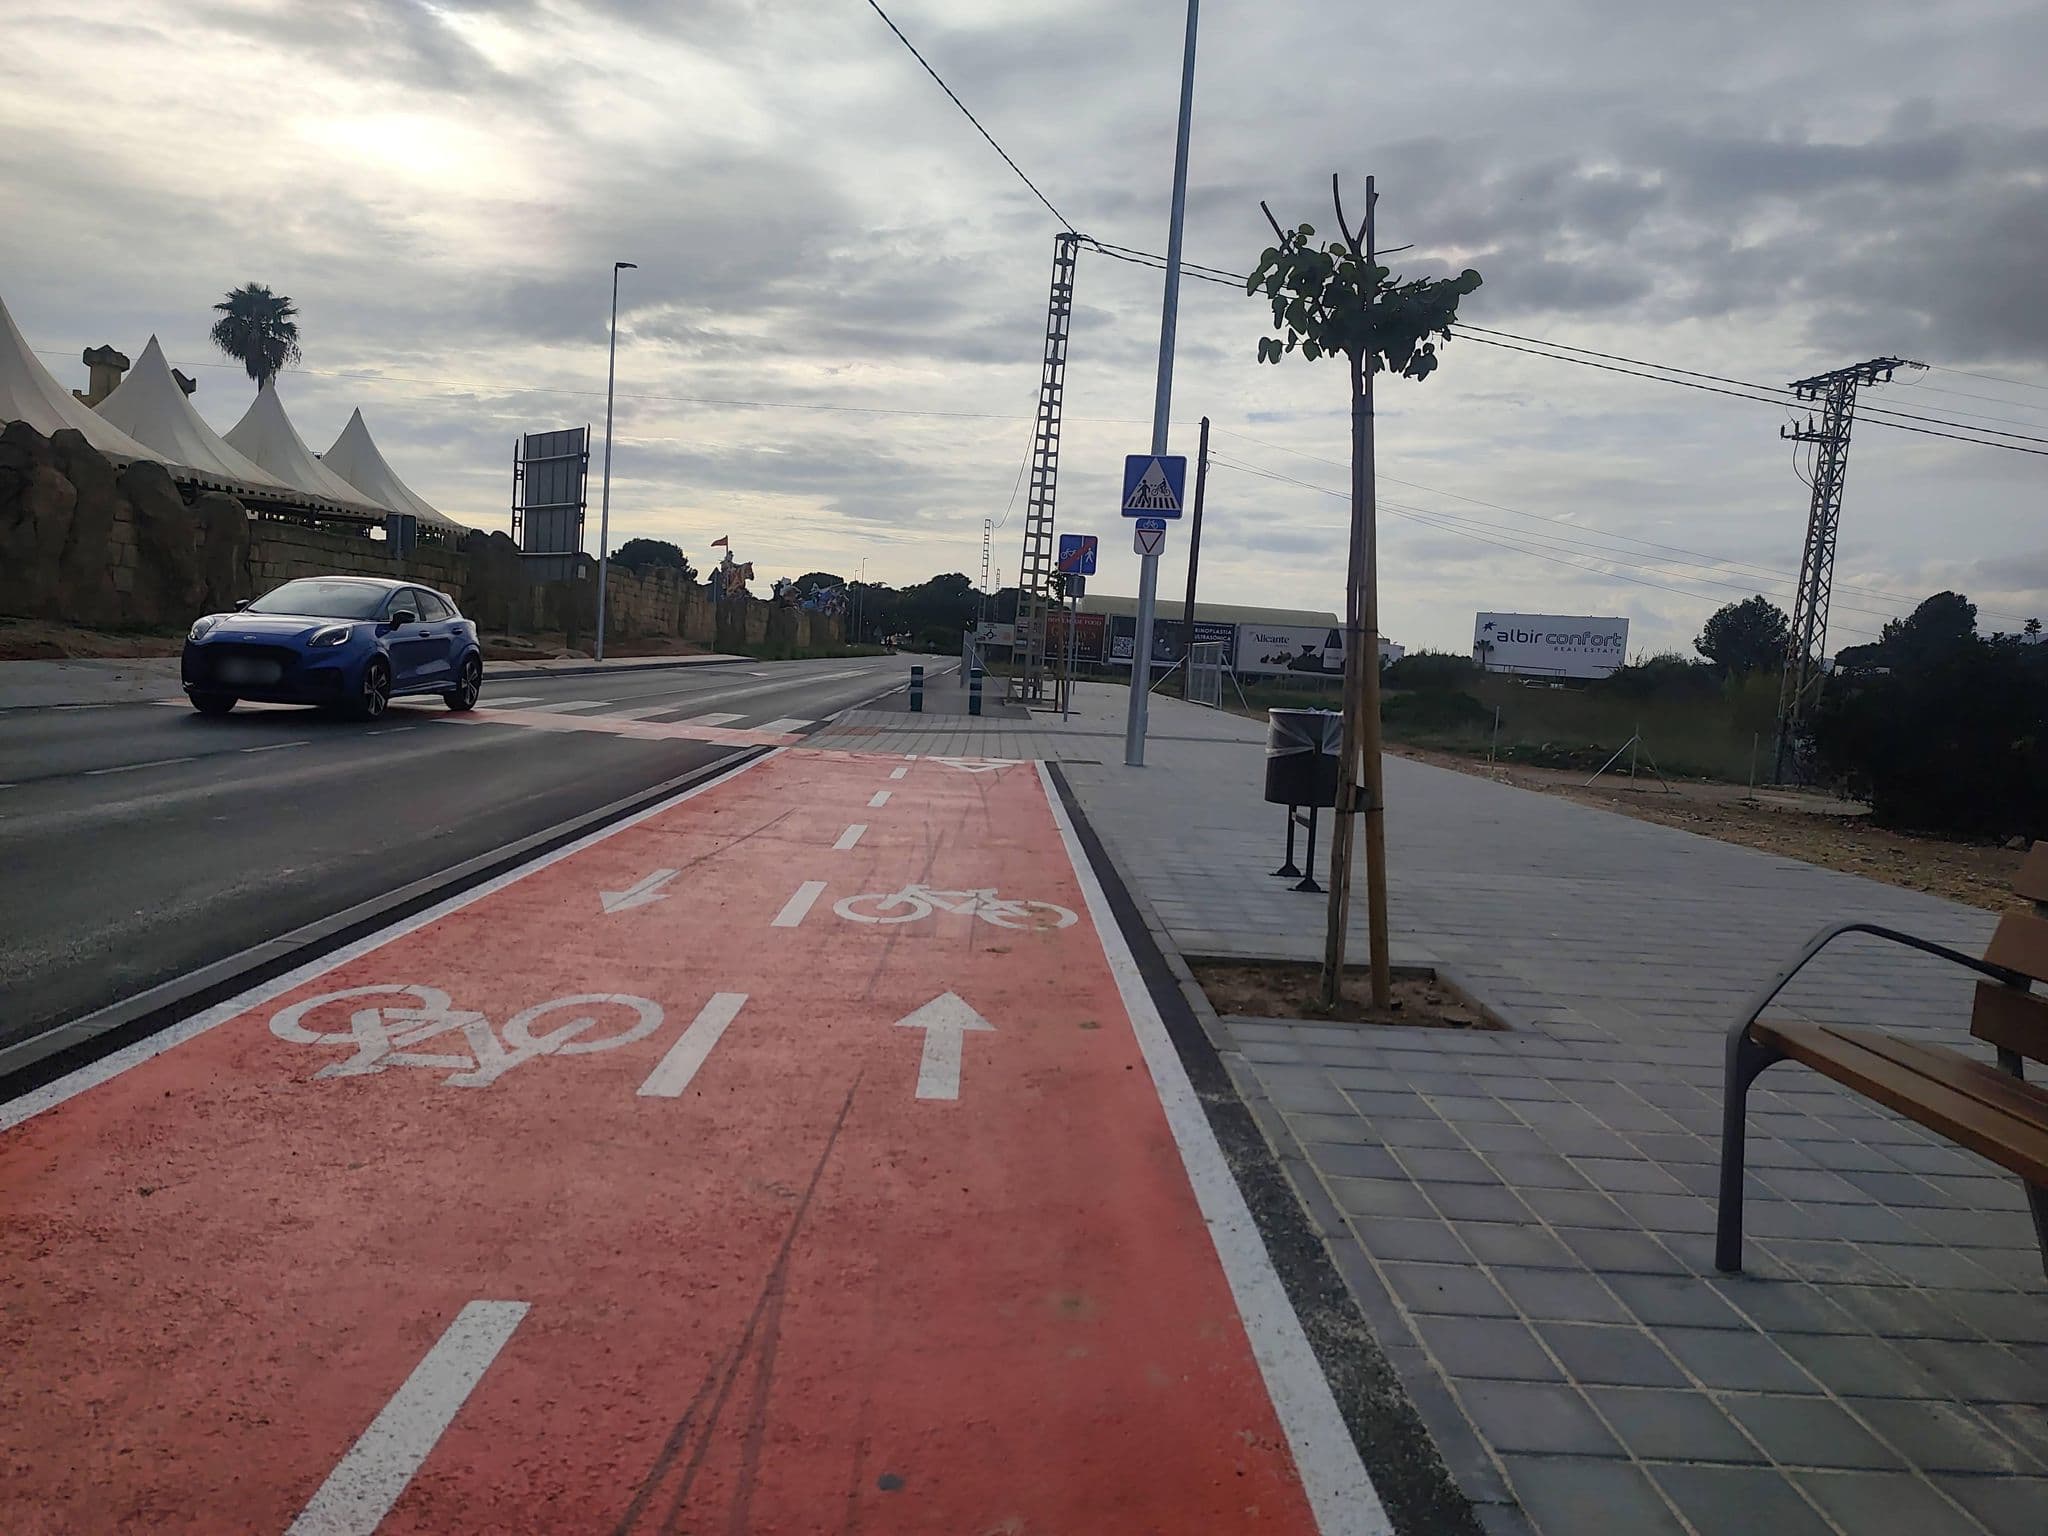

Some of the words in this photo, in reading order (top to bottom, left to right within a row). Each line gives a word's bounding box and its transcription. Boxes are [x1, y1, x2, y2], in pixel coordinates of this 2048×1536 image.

[1255, 633, 1290, 644] Alicante
[1496, 629, 1543, 644] albir
[1545, 631, 1622, 647] confort
